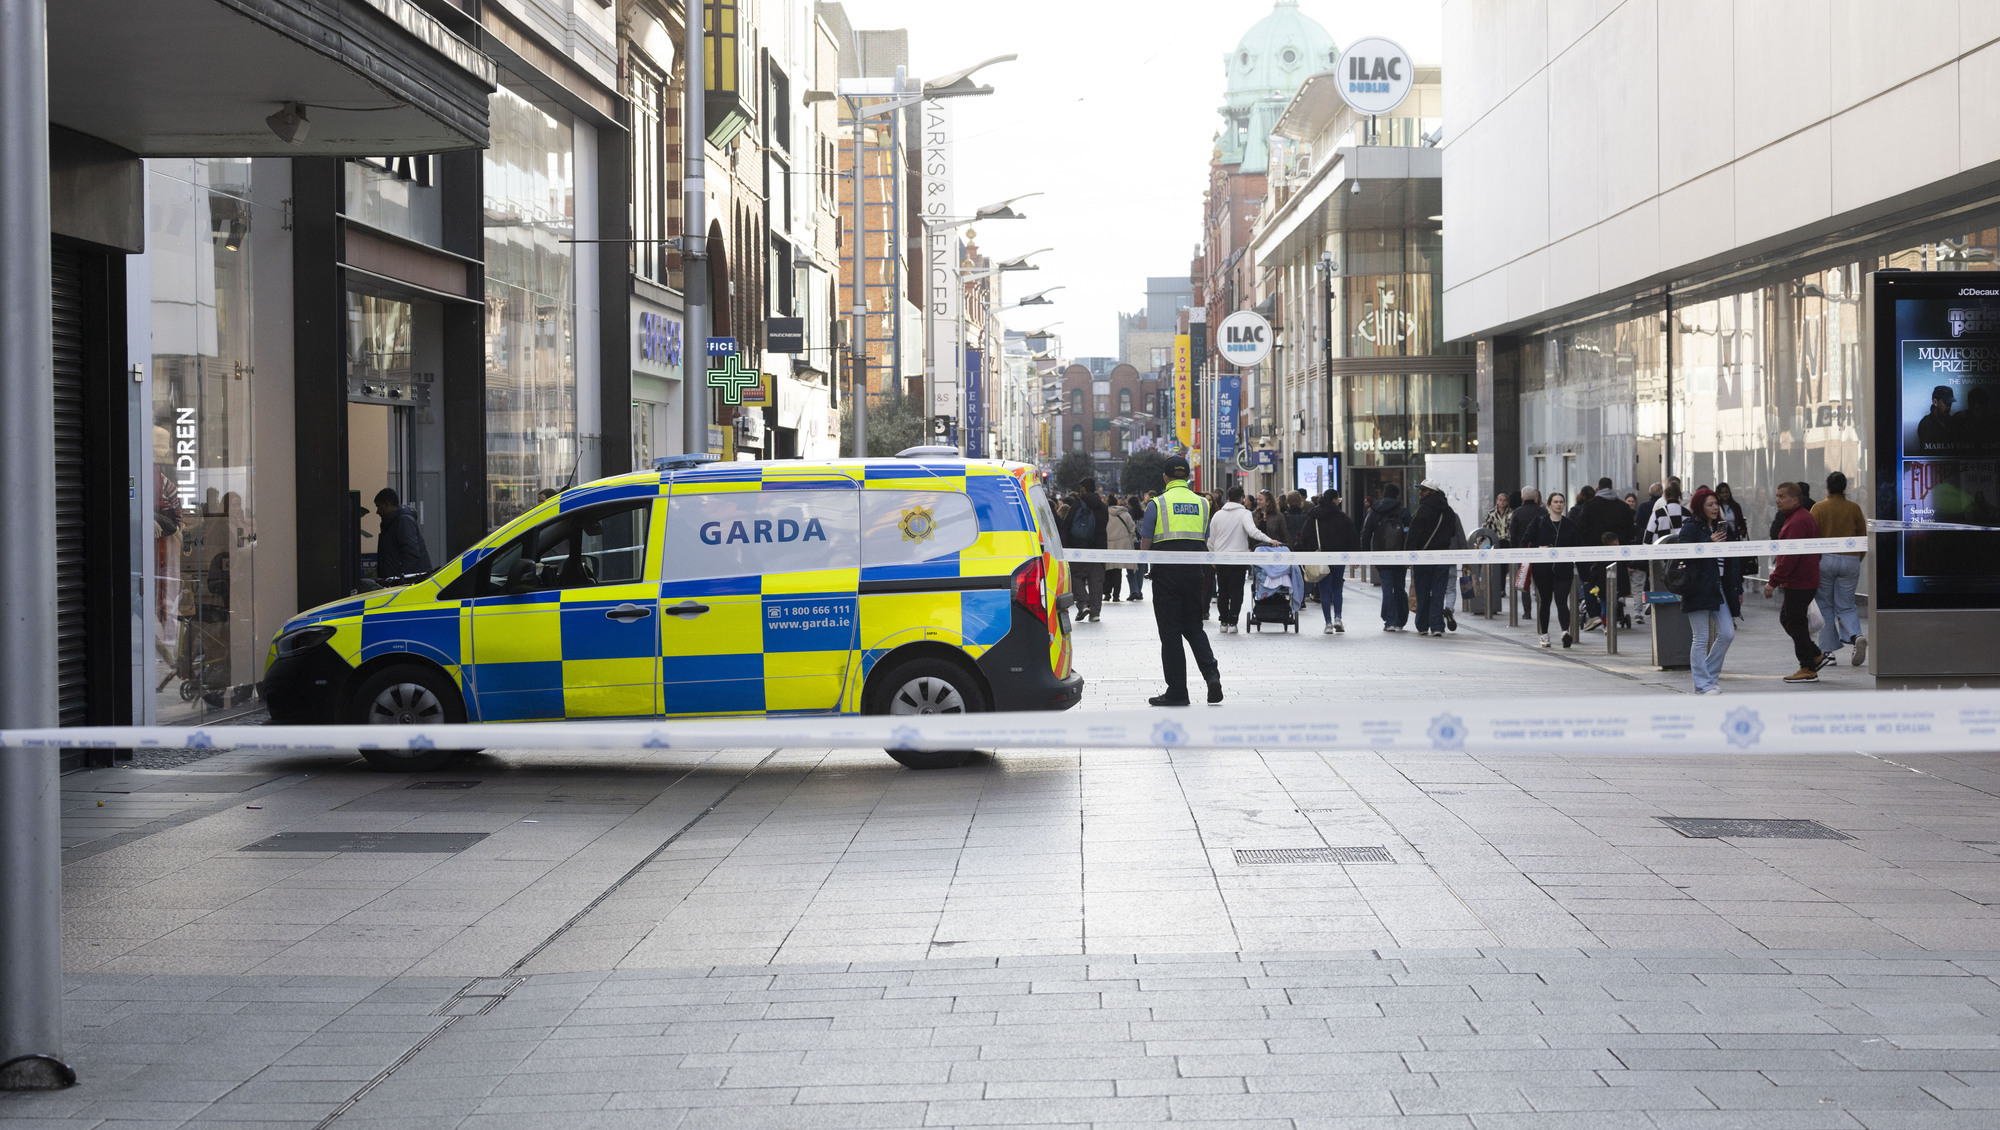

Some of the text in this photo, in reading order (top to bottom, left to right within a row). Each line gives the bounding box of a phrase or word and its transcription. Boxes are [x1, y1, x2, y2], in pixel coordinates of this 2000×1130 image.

[1349, 56, 1402, 81] ILAC
[1349, 82, 1390, 93] DUBLIN
[927, 96, 945, 176] MARKS
[928, 183, 945, 197] &
[1958, 288, 2000, 296] JCDecaux
[1949, 305, 2000, 321] marla
[1227, 326, 1264, 343] ILAC
[1227, 344, 1256, 352] DUBLIN
[1918, 347, 1990, 360] MUMFORD
[1178, 347, 1187, 428] TOYMASTER
[936, 393, 950, 402] &S
[968, 372, 978, 451] JERVIS
[1924, 442, 1955, 450] MARLAY
[176, 407, 196, 514] HILDREN
[1174, 503, 1199, 514] GARDA
[1910, 507, 1935, 516] Sunday
[700, 518, 827, 546] GARDA
[783, 605, 850, 616] 1 800 666 111
[768, 617, 850, 630] www.garda.ie
